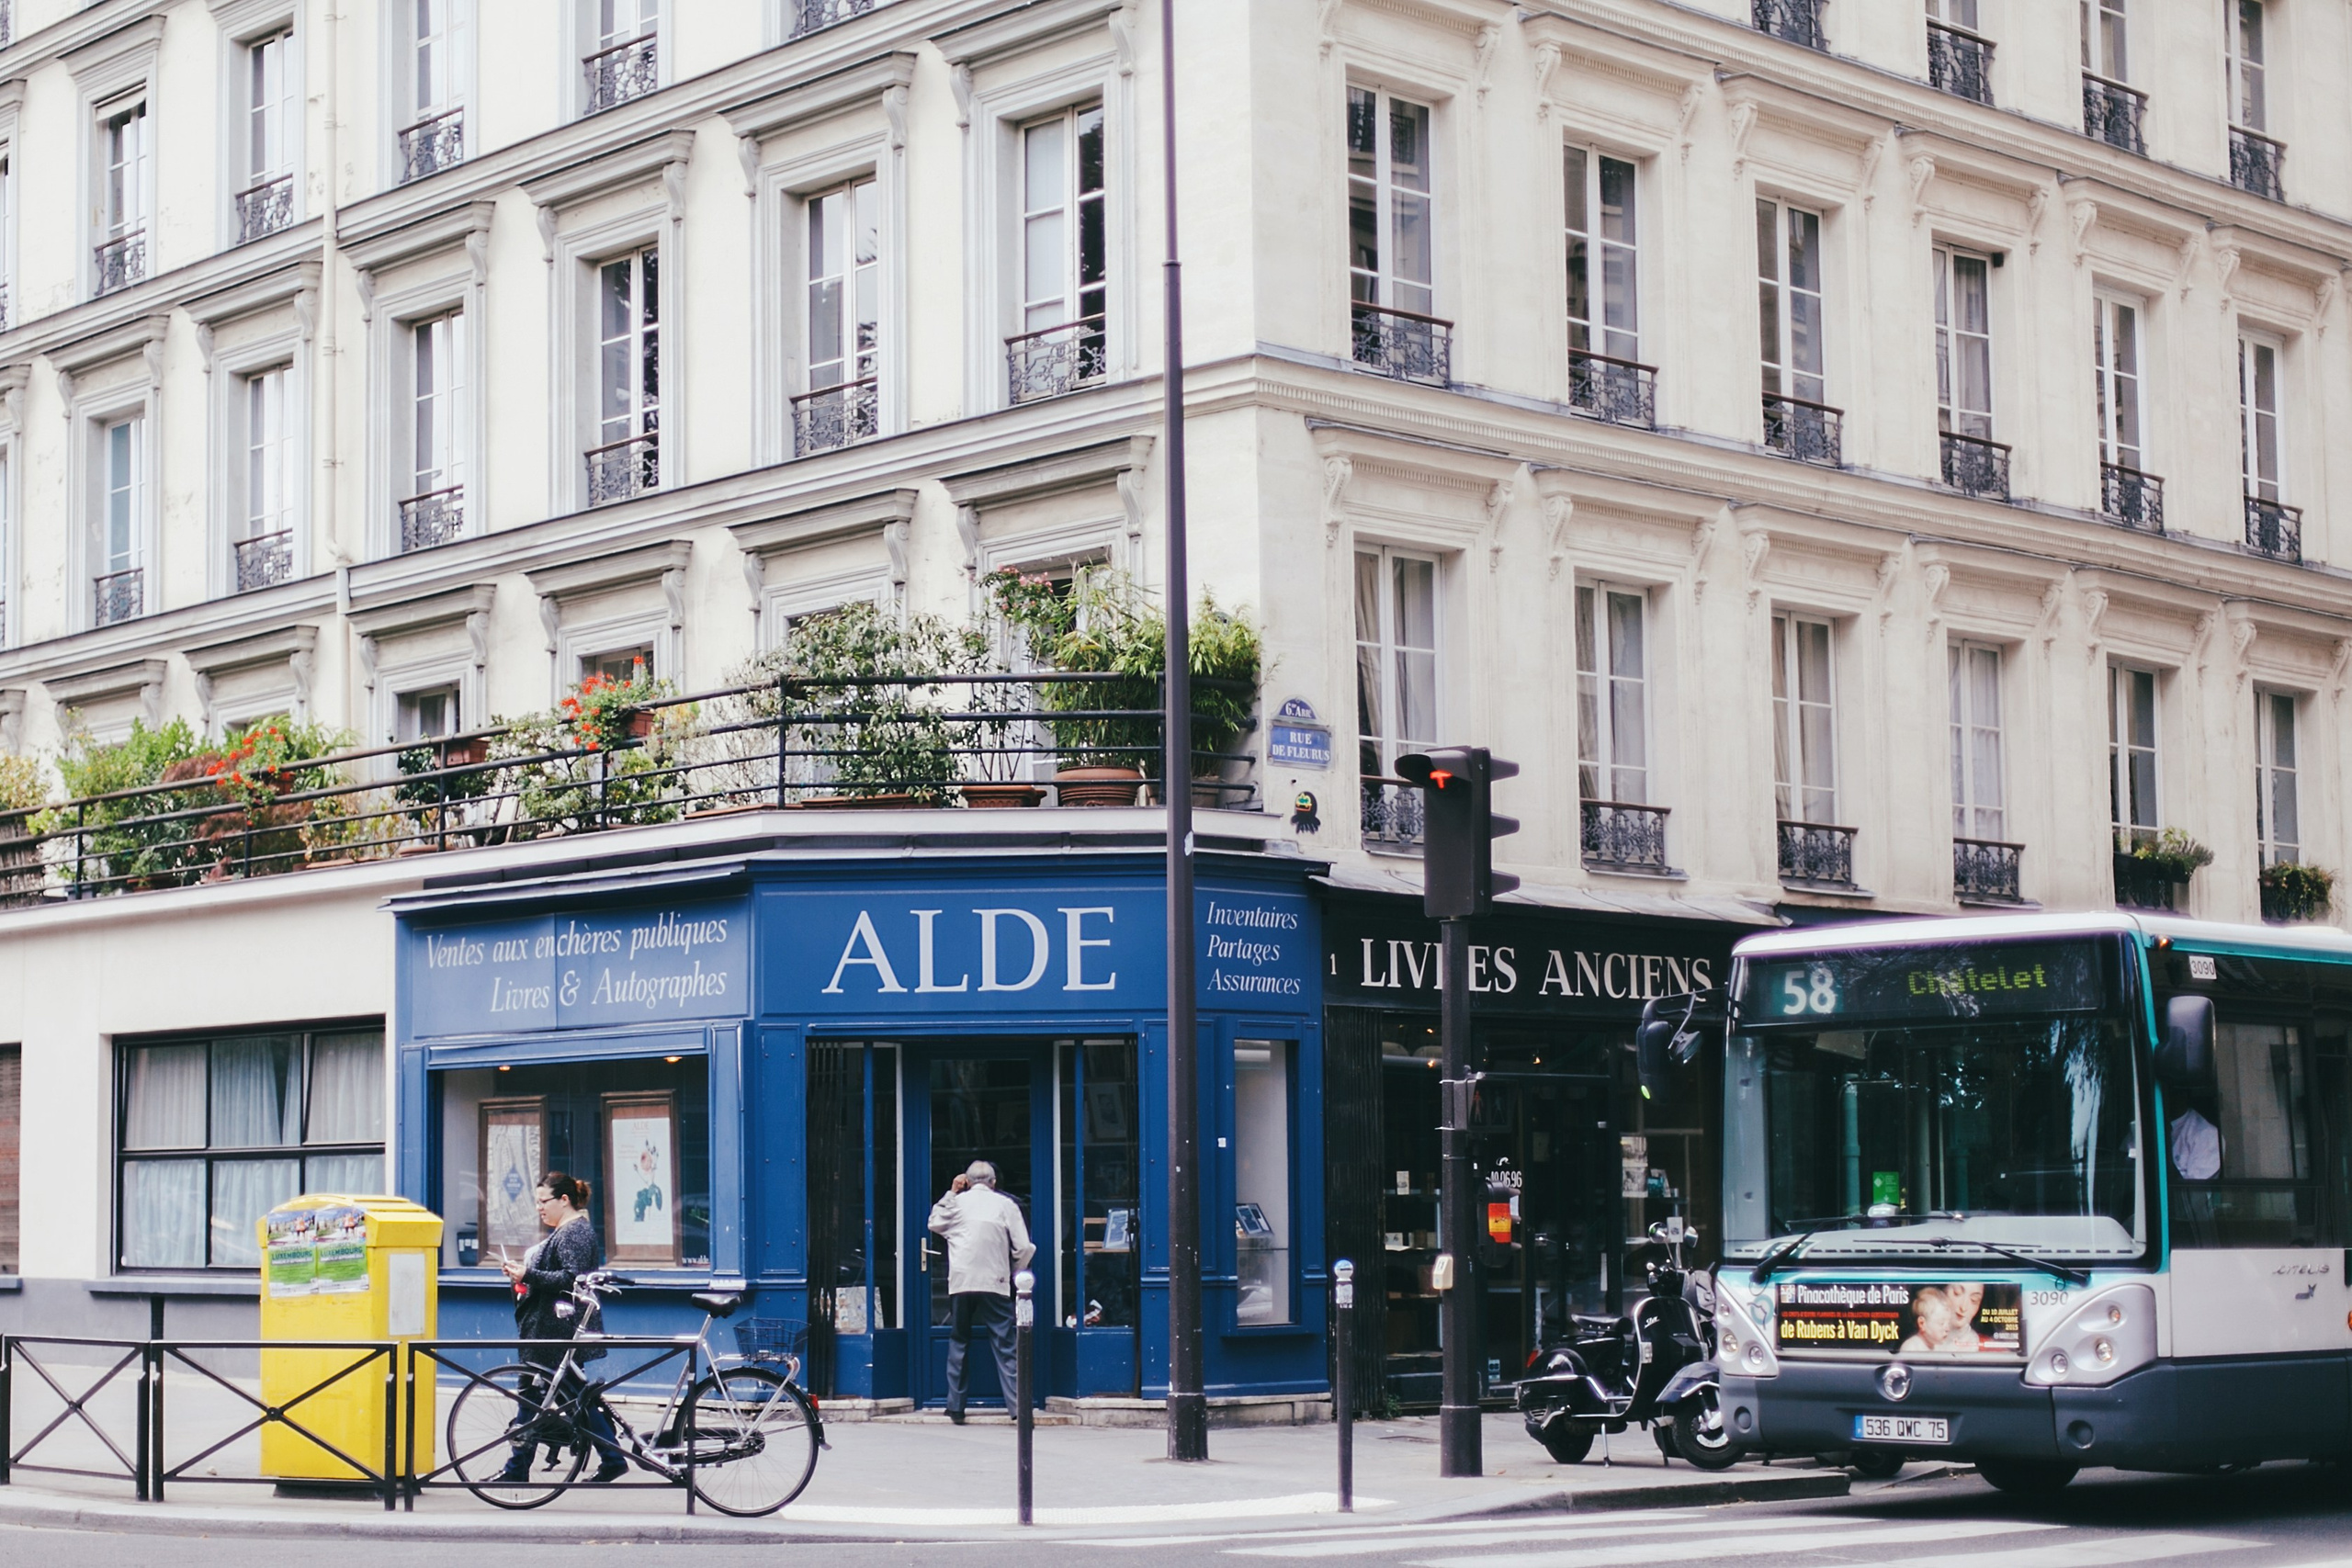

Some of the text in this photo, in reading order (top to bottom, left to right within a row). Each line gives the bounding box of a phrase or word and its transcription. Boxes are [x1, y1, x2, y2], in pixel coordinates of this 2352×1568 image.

[1290, 731, 1311, 744] RUE
[1272, 744, 1330, 761] DE FLEURUS
[1205, 901, 1298, 931] Inventaires
[426, 911, 727, 969] Ventes aux enchères publiques
[821, 906, 1116, 994] ALDE
[1206, 934, 1281, 966] Partages
[1539, 949, 1713, 1002] ANCIENS
[2190, 960, 2215, 976] 3090
[490, 960, 727, 1012] Livres & Autographes
[1207, 968, 1301, 996] Assurances
[1783, 967, 1836, 1015] 58
[271, 1250, 312, 1260] LUXEMBOURG
[320, 1247, 363, 1258] LUXEMBOURG
[1797, 1284, 1909, 1308] Pinacothèque de Paris
[2030, 1291, 2068, 1306] 3090
[1781, 1319, 1899, 1344] de Rubens à Van Dyck
[1866, 1419, 1945, 1438] 536 QWC 75
